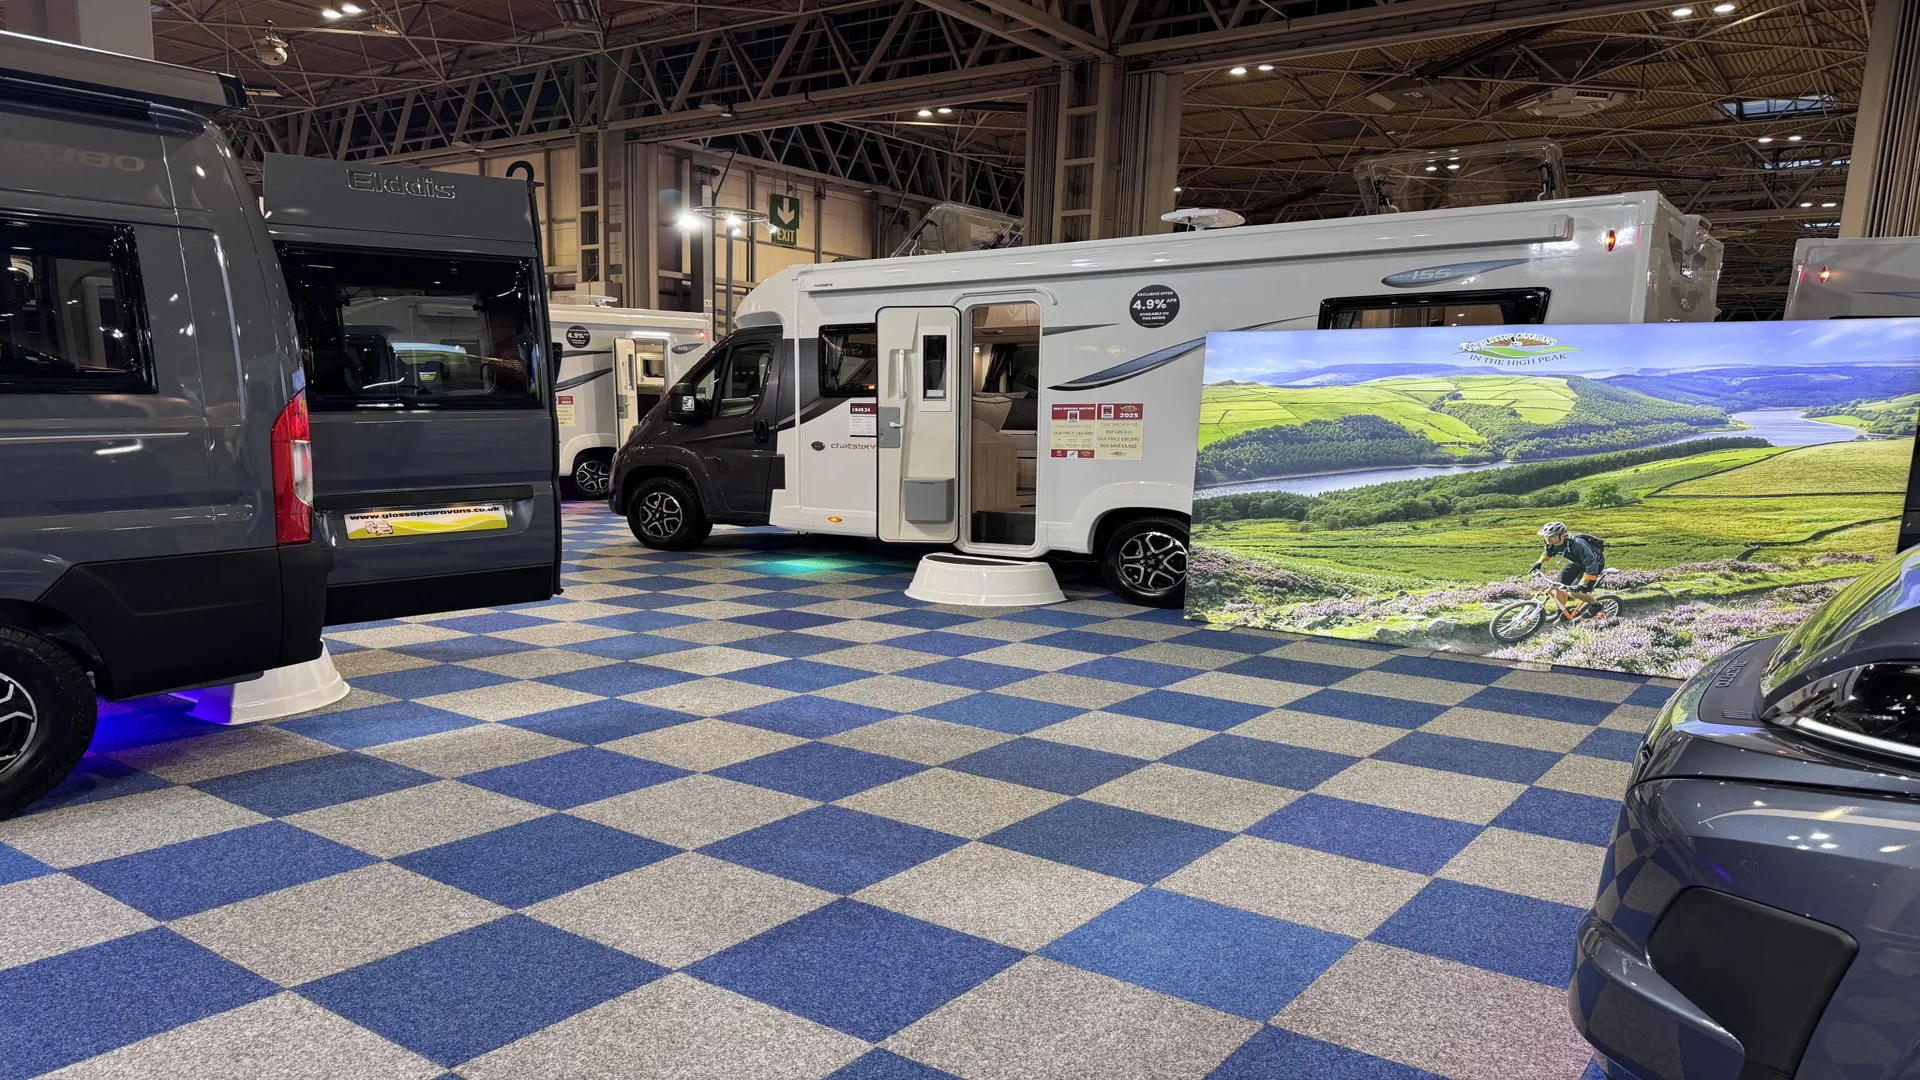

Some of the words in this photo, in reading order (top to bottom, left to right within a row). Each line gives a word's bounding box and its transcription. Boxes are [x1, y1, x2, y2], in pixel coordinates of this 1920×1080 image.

[346, 169, 456, 200] Elddis
[776, 227, 796, 243] EXIT
[1132, 299, 1167, 310] 4.9%
[1515, 332, 1557, 347] CARAVANS
[1469, 354, 1480, 362] IN
[1483, 356, 1504, 366] THE
[1538, 353, 1567, 364] PEAK
[350, 505, 500, 521] www.glossopcaravans.co.uk
